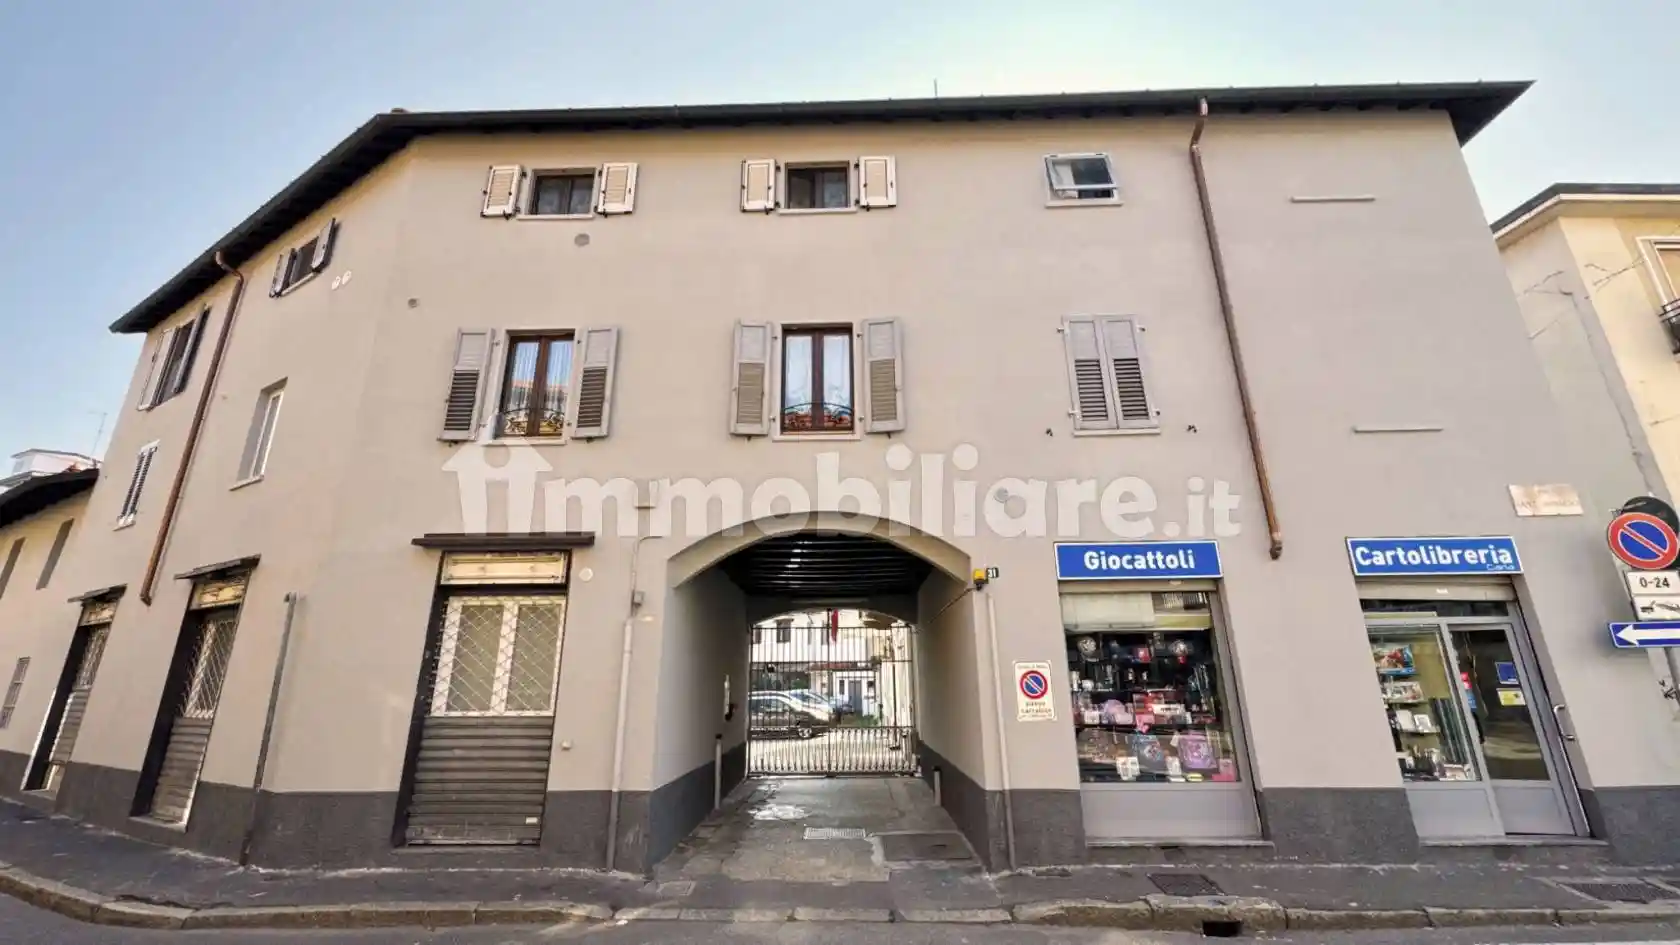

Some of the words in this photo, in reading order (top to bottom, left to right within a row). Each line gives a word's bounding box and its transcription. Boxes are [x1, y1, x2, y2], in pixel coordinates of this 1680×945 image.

[1083, 549, 1196, 570] Giocattoli
[1355, 544, 1513, 566] Cartolibreria
[1639, 576, 1670, 589] 0-24
